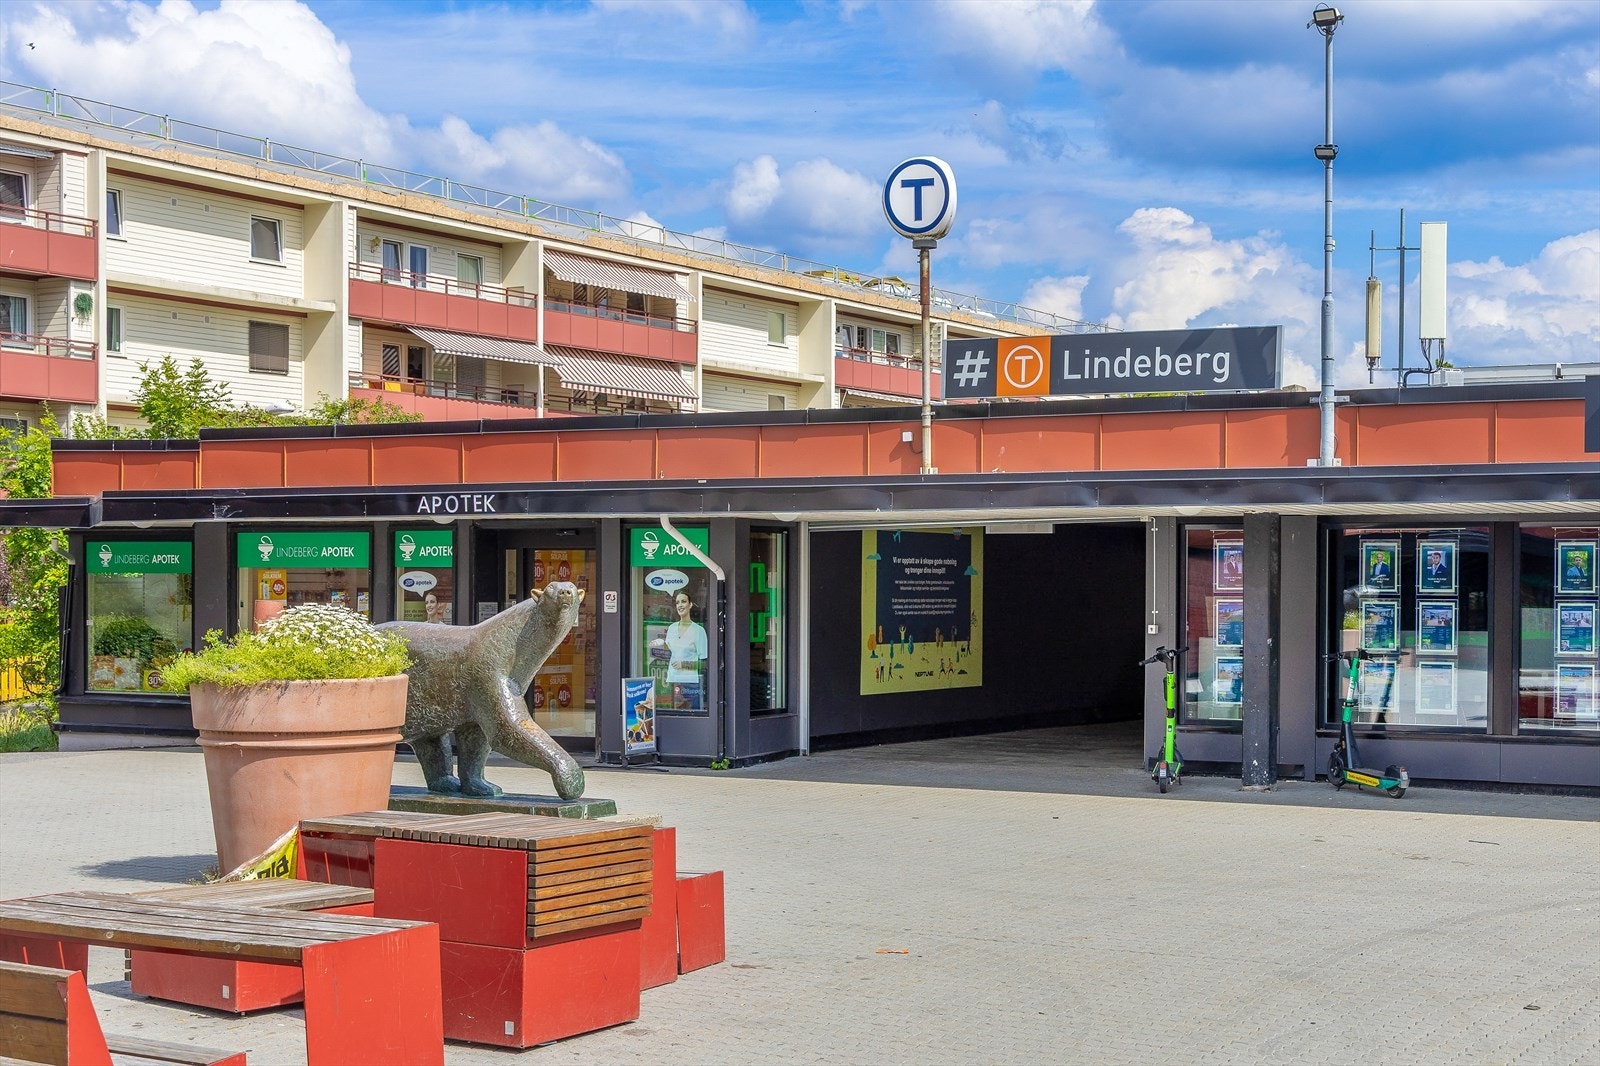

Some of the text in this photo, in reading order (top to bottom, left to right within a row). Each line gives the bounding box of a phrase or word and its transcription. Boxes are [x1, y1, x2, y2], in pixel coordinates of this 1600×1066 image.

[901, 177, 934, 221] T
[1063, 346, 1231, 383] Lindeberg
[417, 494, 496, 513] APOTEK
[276, 546, 354, 557] LINDEBERG APOTEK
[419, 546, 453, 557] APOTEK
[663, 544, 702, 555] APOT
[114, 554, 180, 564] LINDEBERG APOTEK
